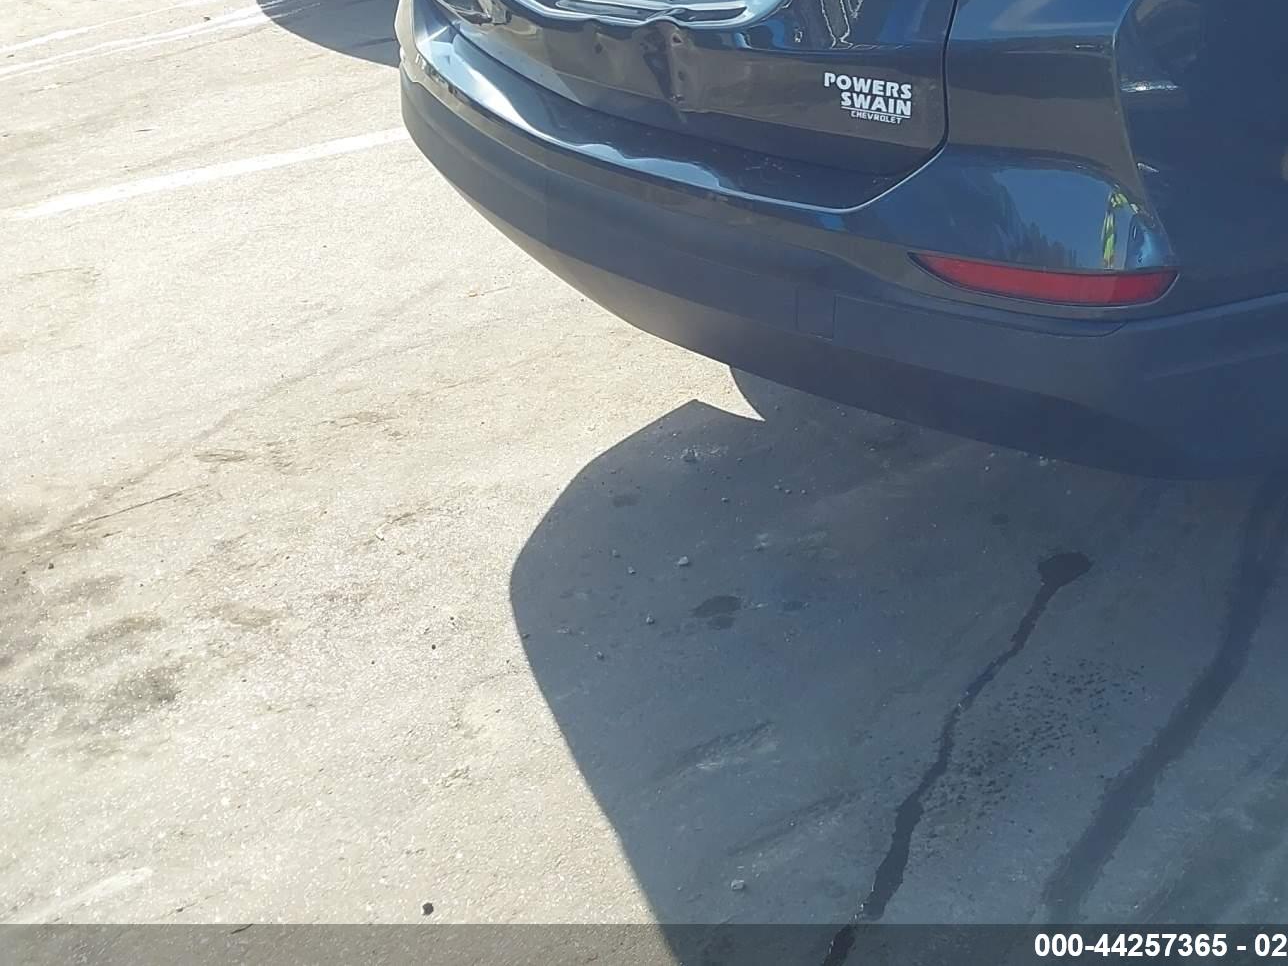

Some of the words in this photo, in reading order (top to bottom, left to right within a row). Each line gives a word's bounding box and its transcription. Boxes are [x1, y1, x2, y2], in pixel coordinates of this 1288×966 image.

[824, 72, 912, 99] POWERS
[841, 91, 912, 116] SWAIN
[851, 110, 902, 124] CHEVROLET
